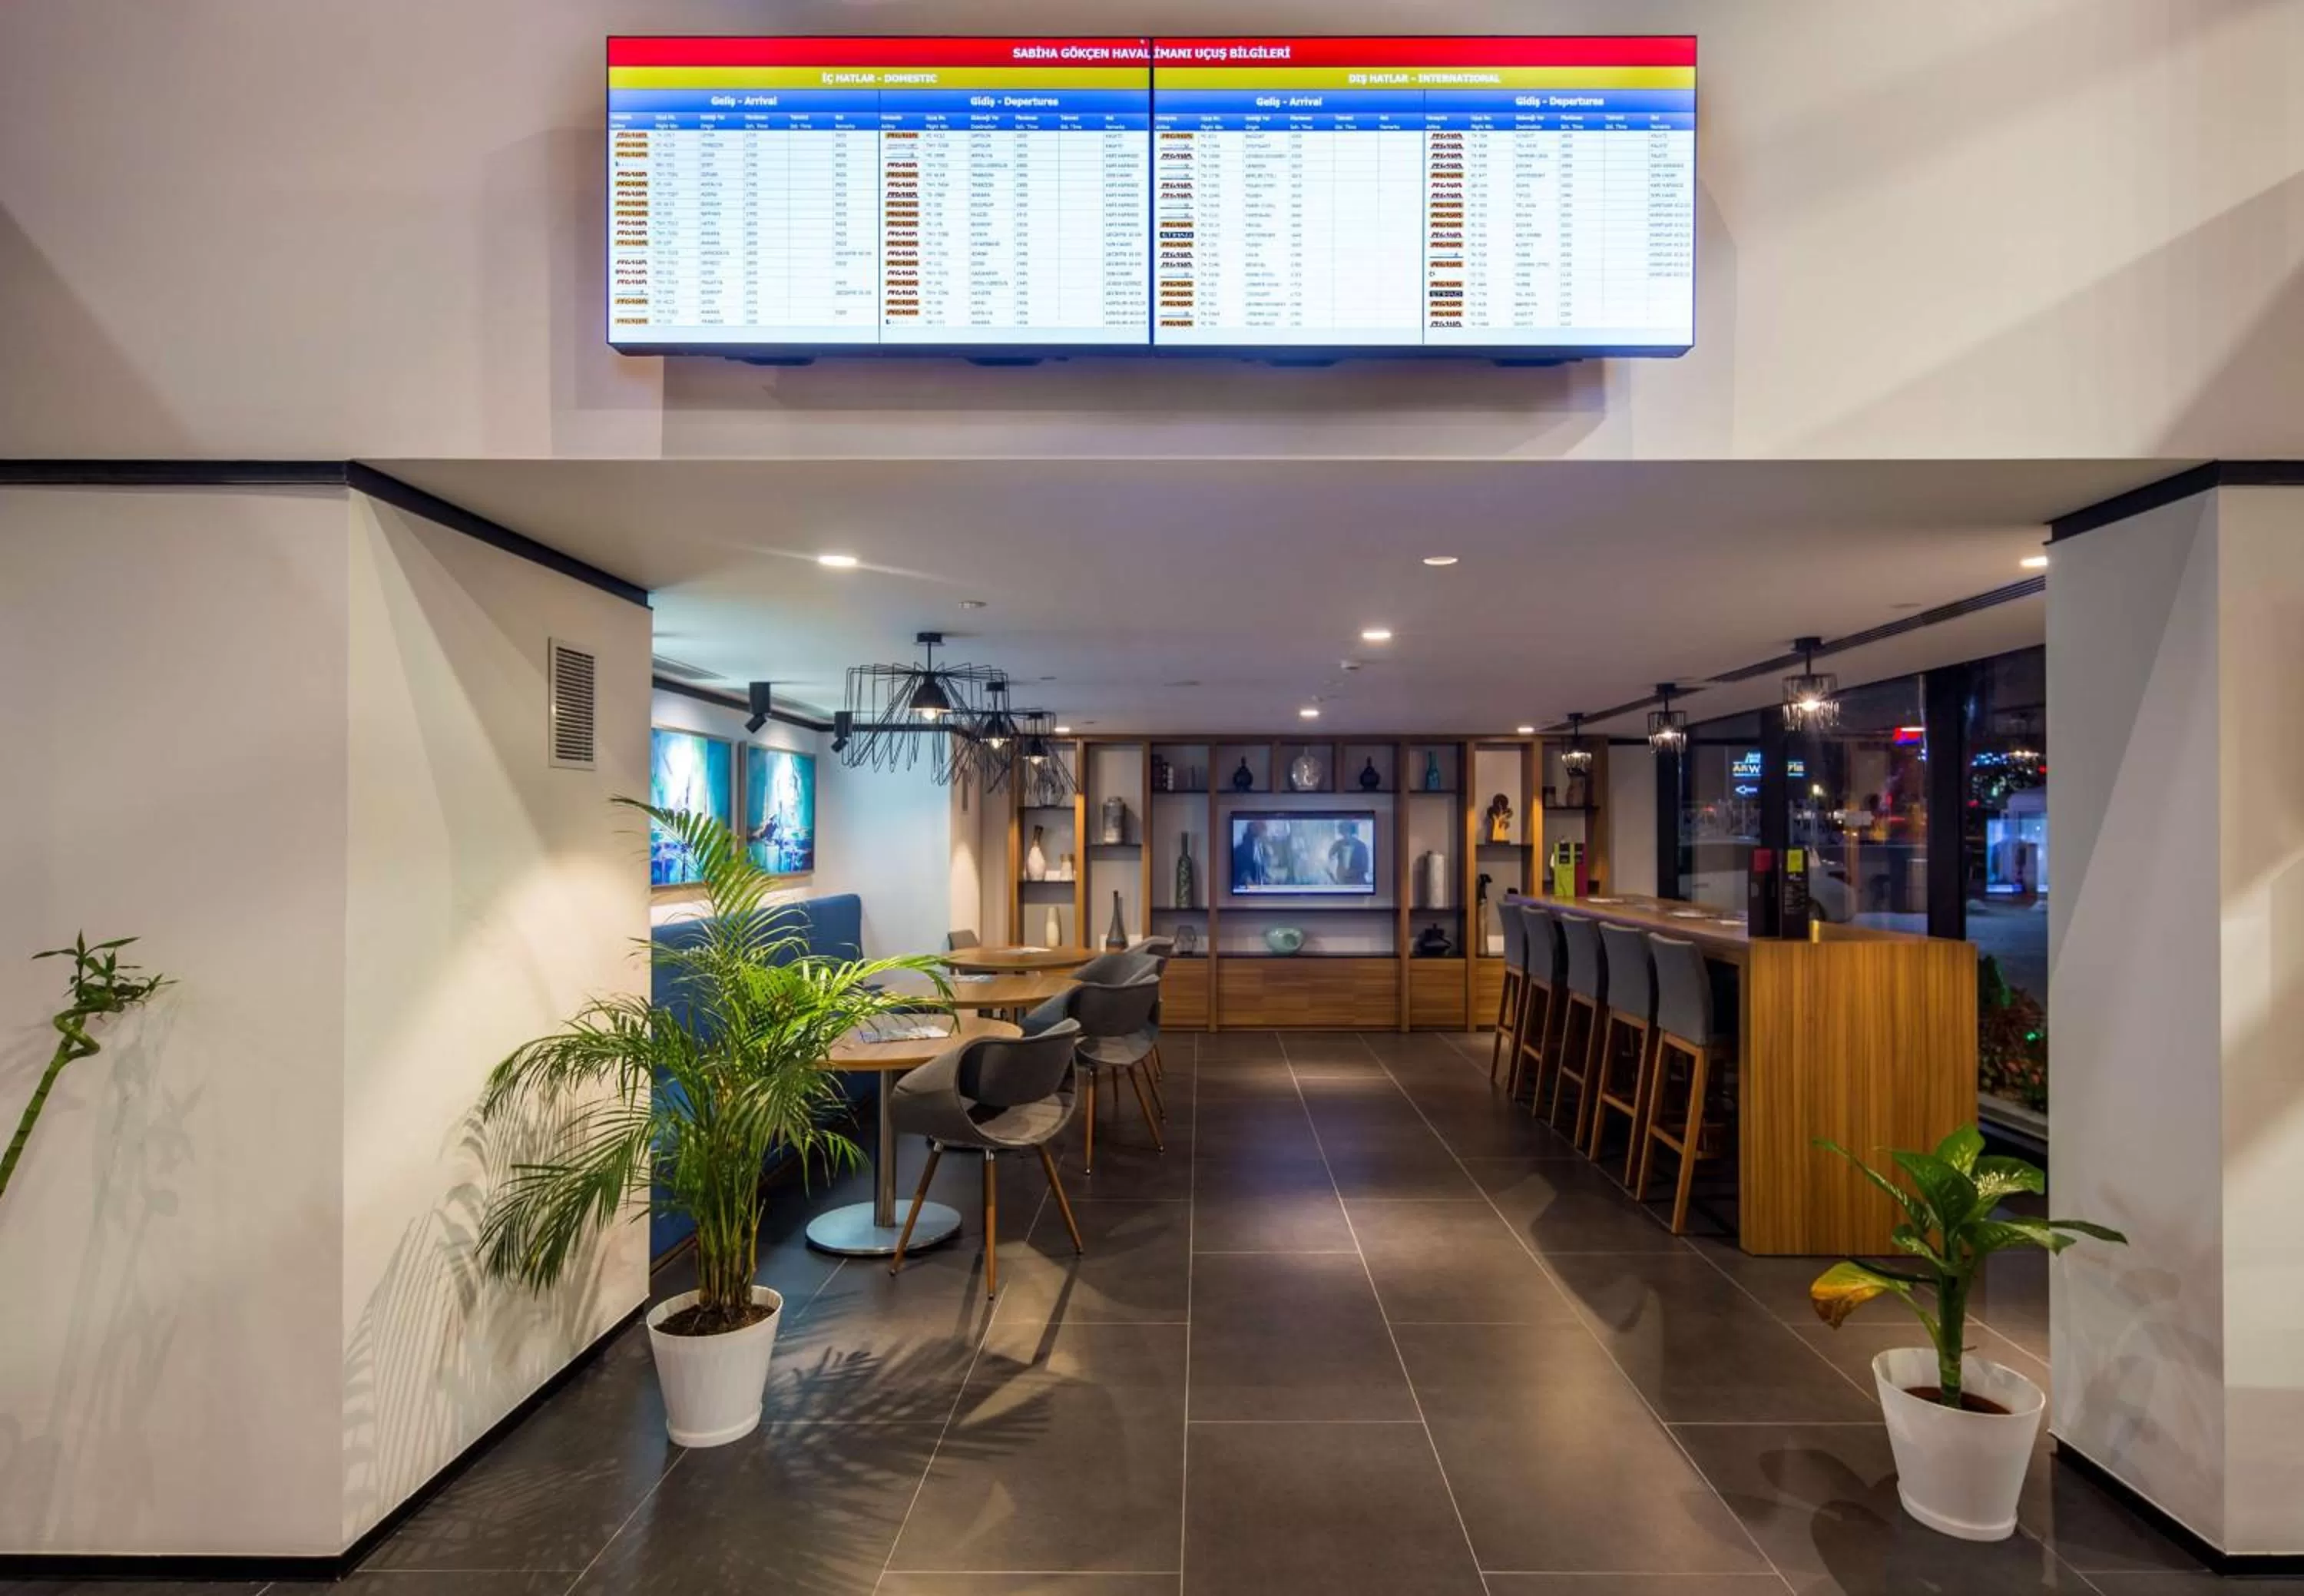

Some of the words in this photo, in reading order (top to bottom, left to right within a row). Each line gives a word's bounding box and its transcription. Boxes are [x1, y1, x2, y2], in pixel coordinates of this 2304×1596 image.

[1013, 46, 1058, 58] SABİHA
[1061, 46, 1109, 61] GÖKÇEN
[1195, 48, 1226, 61] UÇUŞ
[1230, 46, 1290, 58] BİLGİLERİ
[836, 74, 876, 83] HATLAR
[885, 74, 938, 83] DOMESTIC
[1369, 74, 1409, 83] HATLAR
[1418, 74, 1501, 84] INTERNATIONAL
[743, 95, 777, 105] Arrival
[1004, 96, 1059, 108] Departures
[1289, 96, 1322, 106] Arrival
[1549, 96, 1604, 108] Departures
